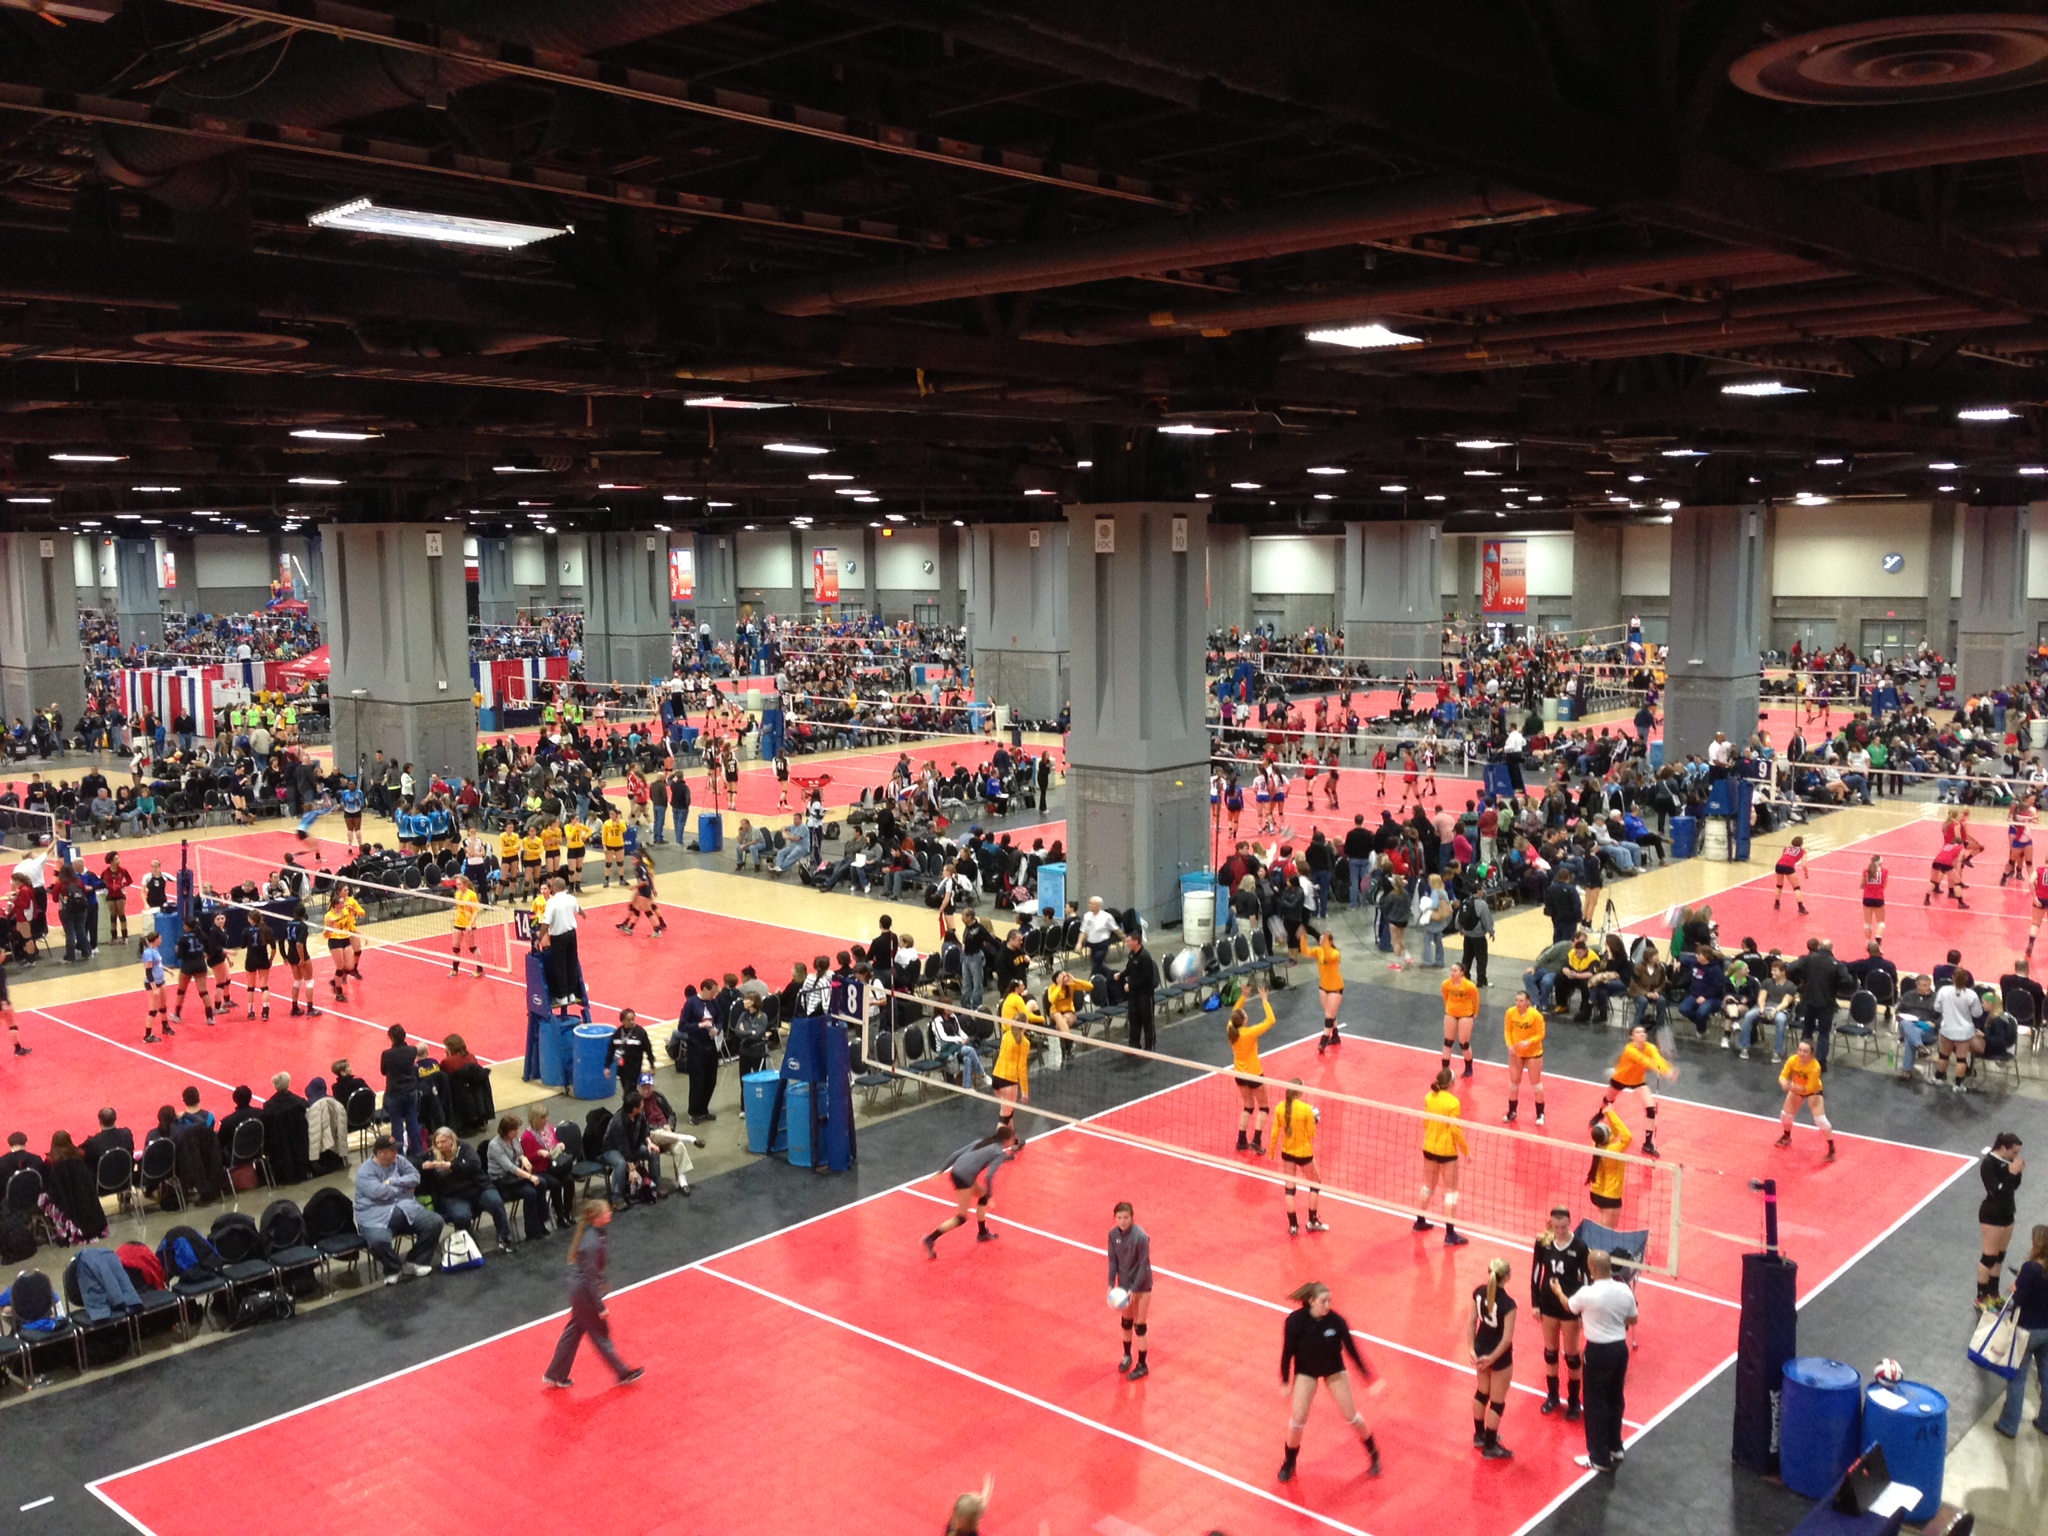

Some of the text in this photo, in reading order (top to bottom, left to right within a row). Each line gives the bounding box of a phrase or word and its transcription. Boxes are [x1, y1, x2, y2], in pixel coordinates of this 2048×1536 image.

[1177, 522, 1183, 533] A
[430, 536, 437, 544] A
[1175, 536, 1184, 548] 10
[1501, 568, 1526, 577] COURTS
[1502, 596, 1525, 605] 12-14
[1861, 673, 1872, 684] 12
[1464, 741, 1477, 757] 13
[1758, 761, 1768, 778] 9
[286, 925, 297, 940] 14
[515, 912, 532, 939] 14
[252, 932, 259, 946] 1
[847, 983, 858, 1014] 8
[1550, 1259, 1565, 1275] 14
